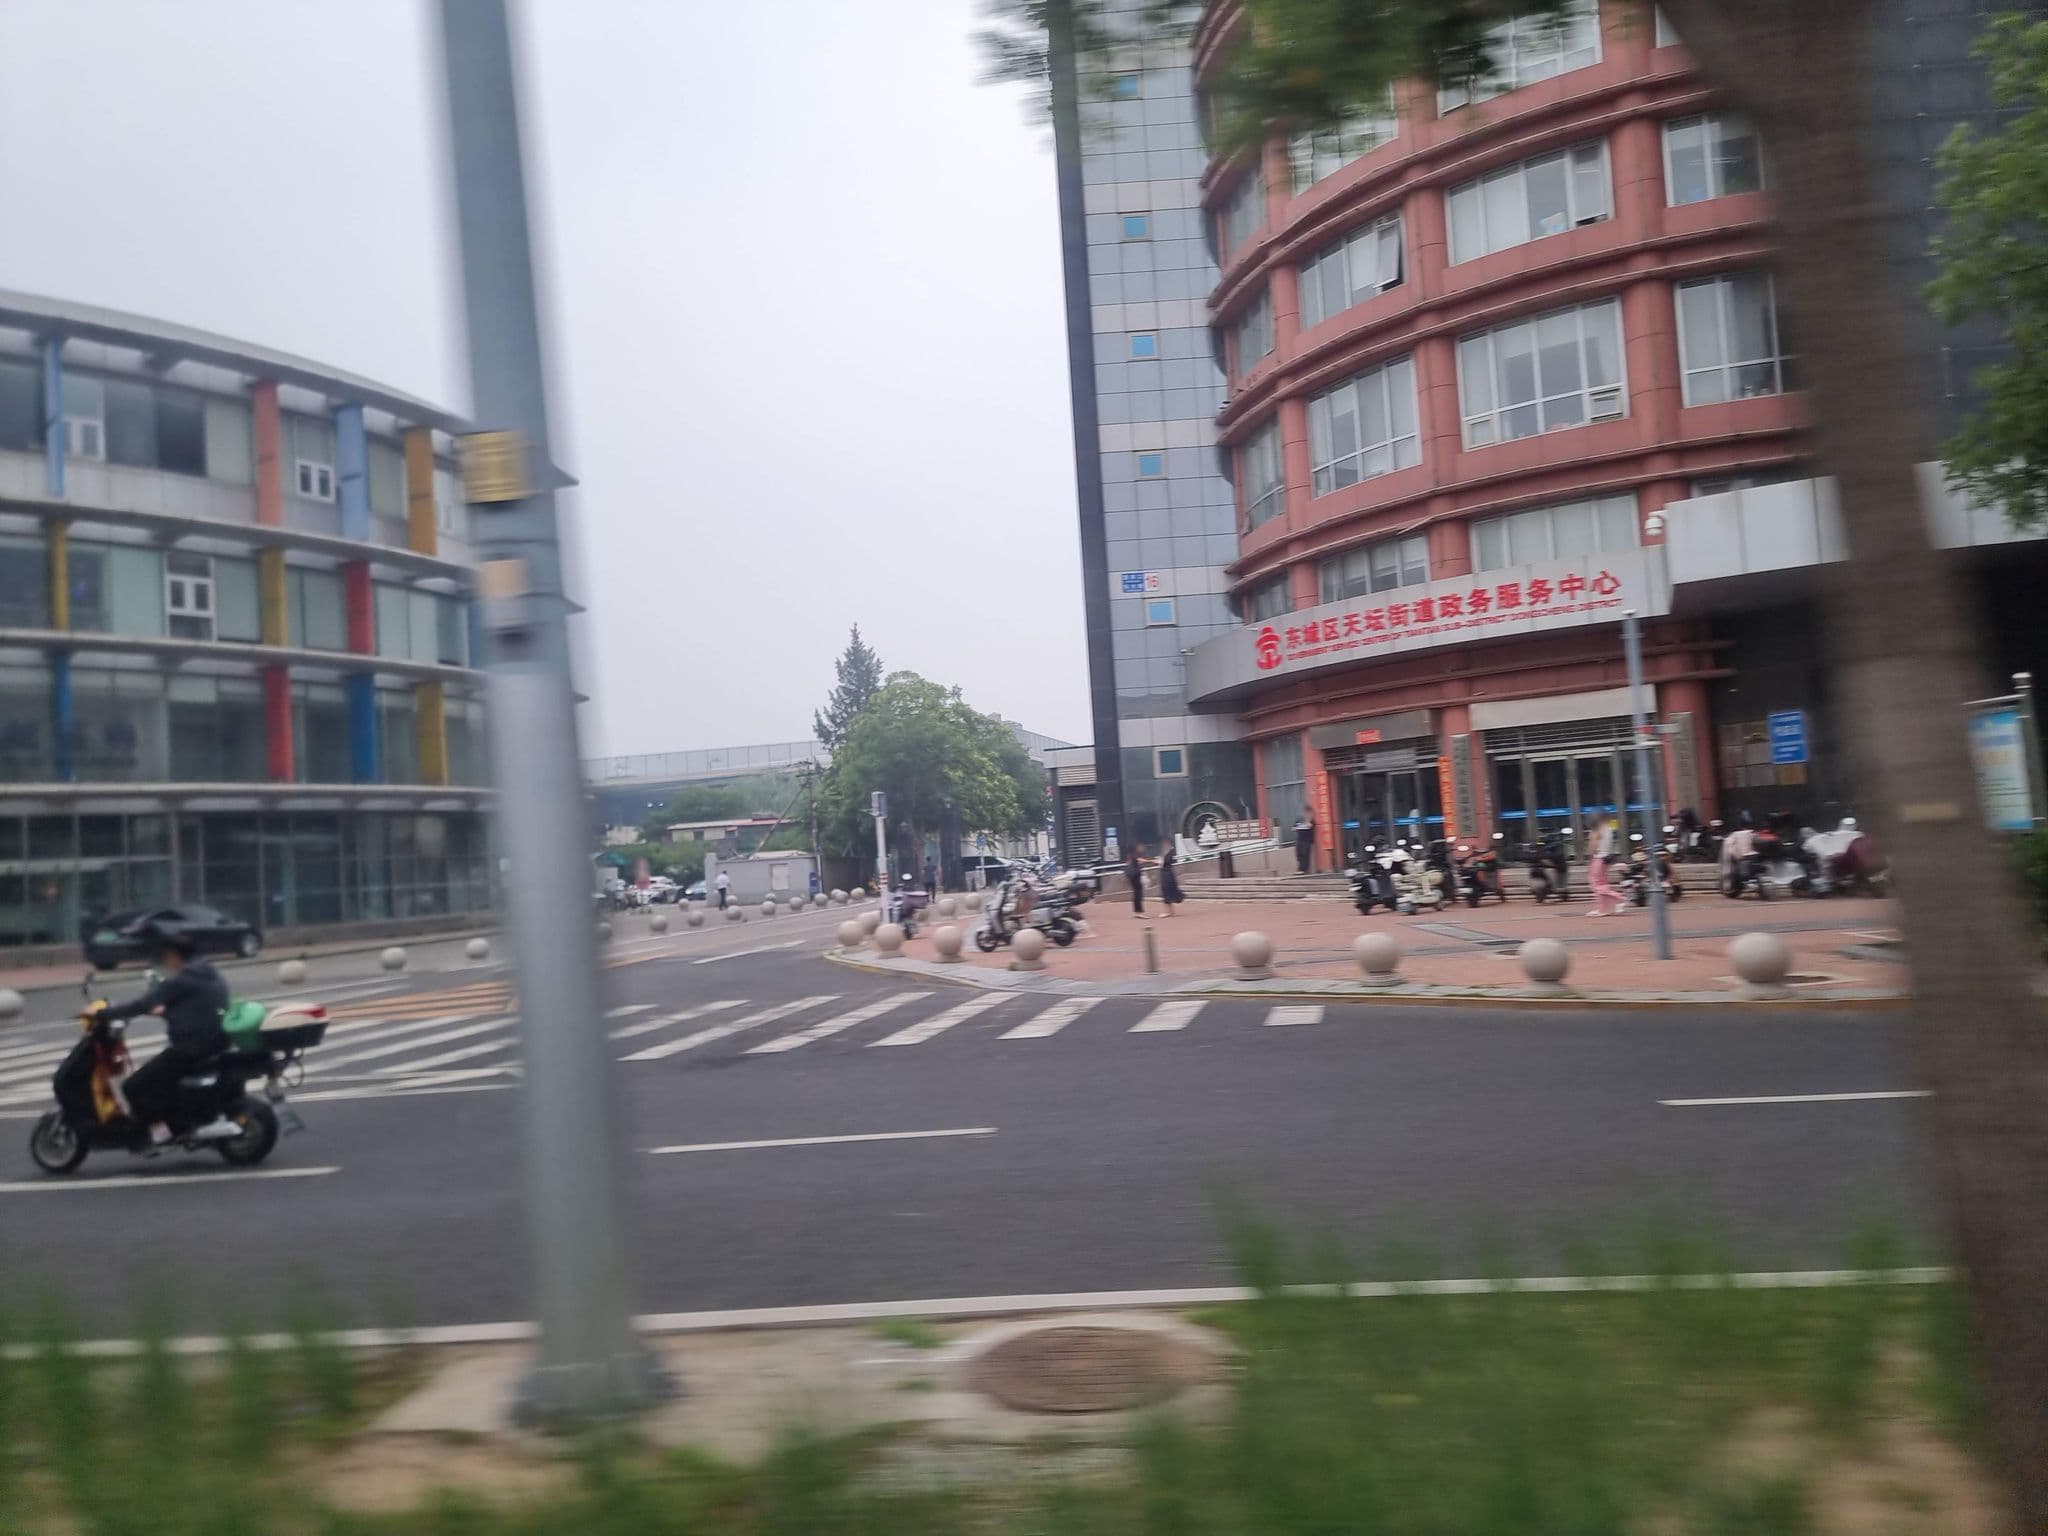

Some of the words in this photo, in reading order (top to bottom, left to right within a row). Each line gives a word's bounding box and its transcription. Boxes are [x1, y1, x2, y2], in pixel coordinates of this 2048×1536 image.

[1286, 569, 1622, 649] 东城区天坛街道政务服务中心
